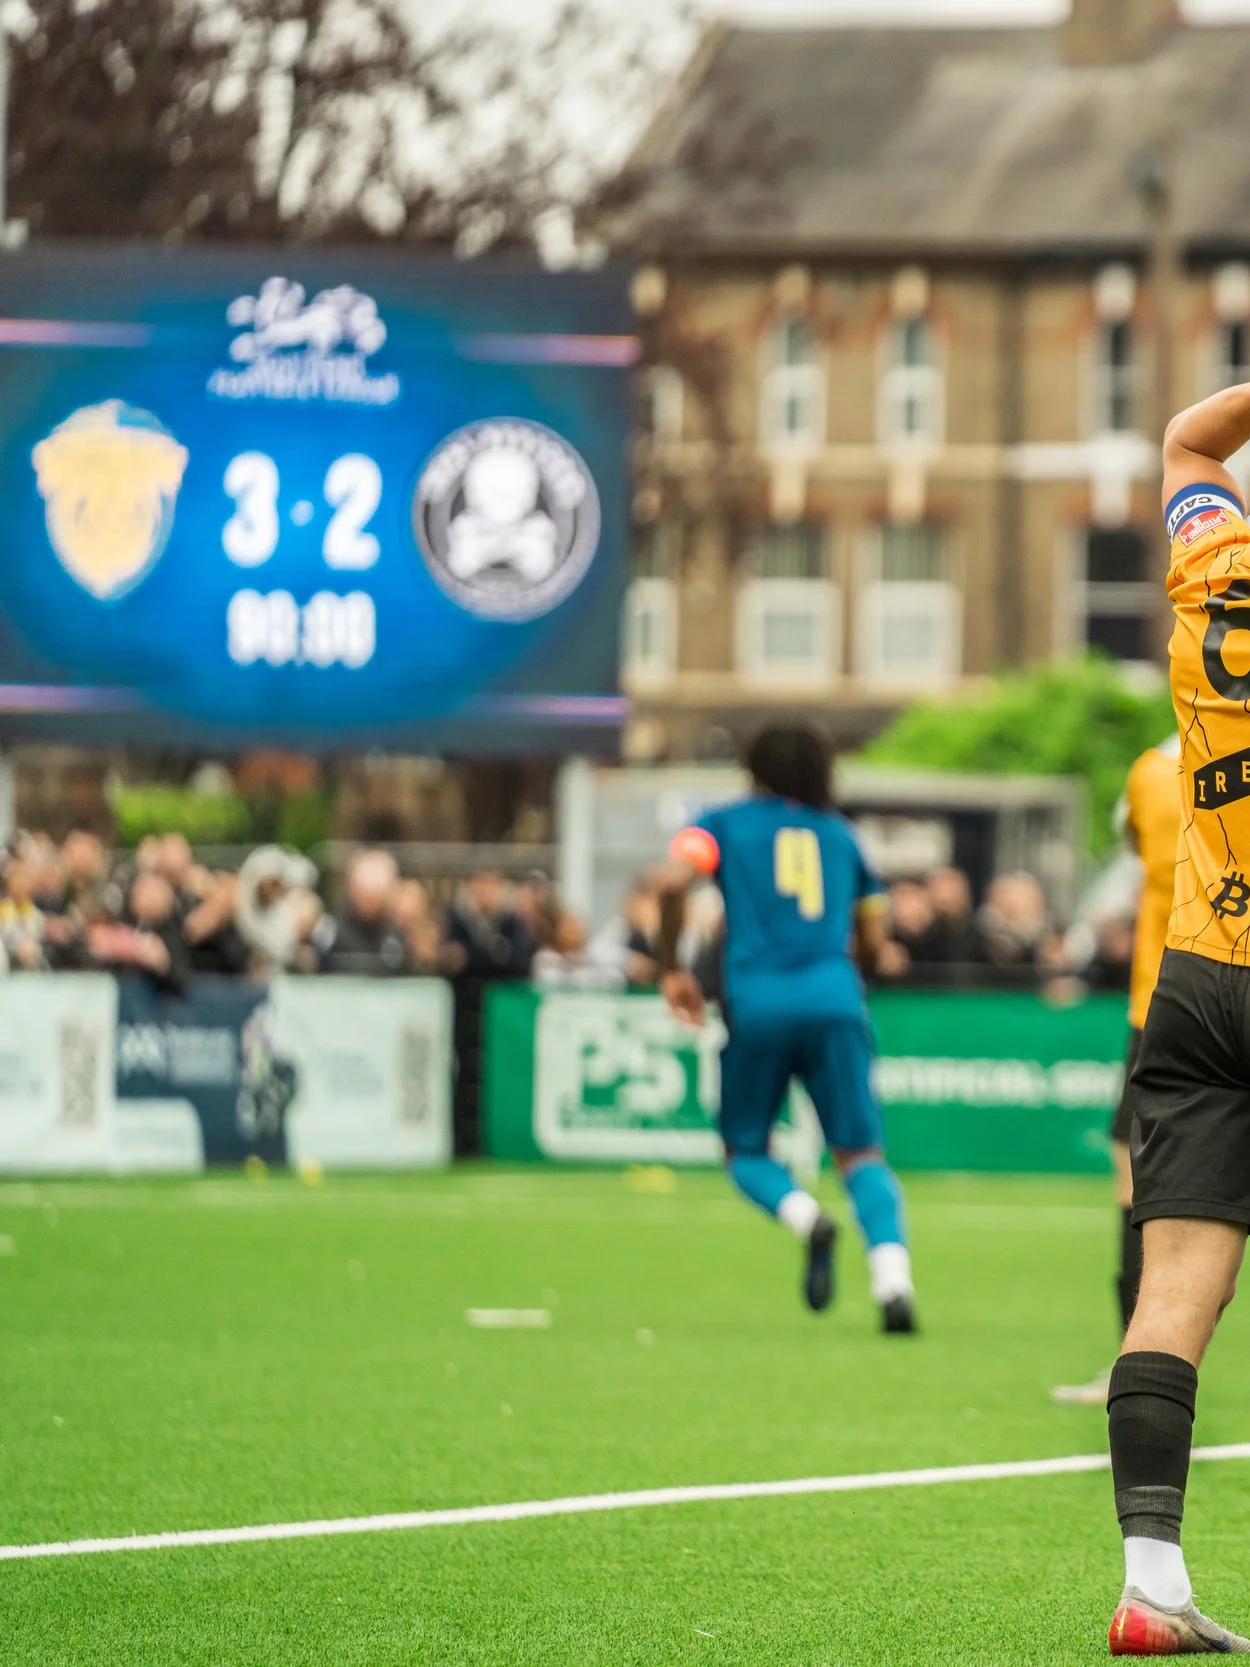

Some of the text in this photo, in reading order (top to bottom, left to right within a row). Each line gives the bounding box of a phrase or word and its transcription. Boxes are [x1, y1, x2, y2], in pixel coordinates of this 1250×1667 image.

[222, 450, 280, 568] 3
[322, 452, 383, 571] 2
[1168, 496, 1213, 535] CAPT
